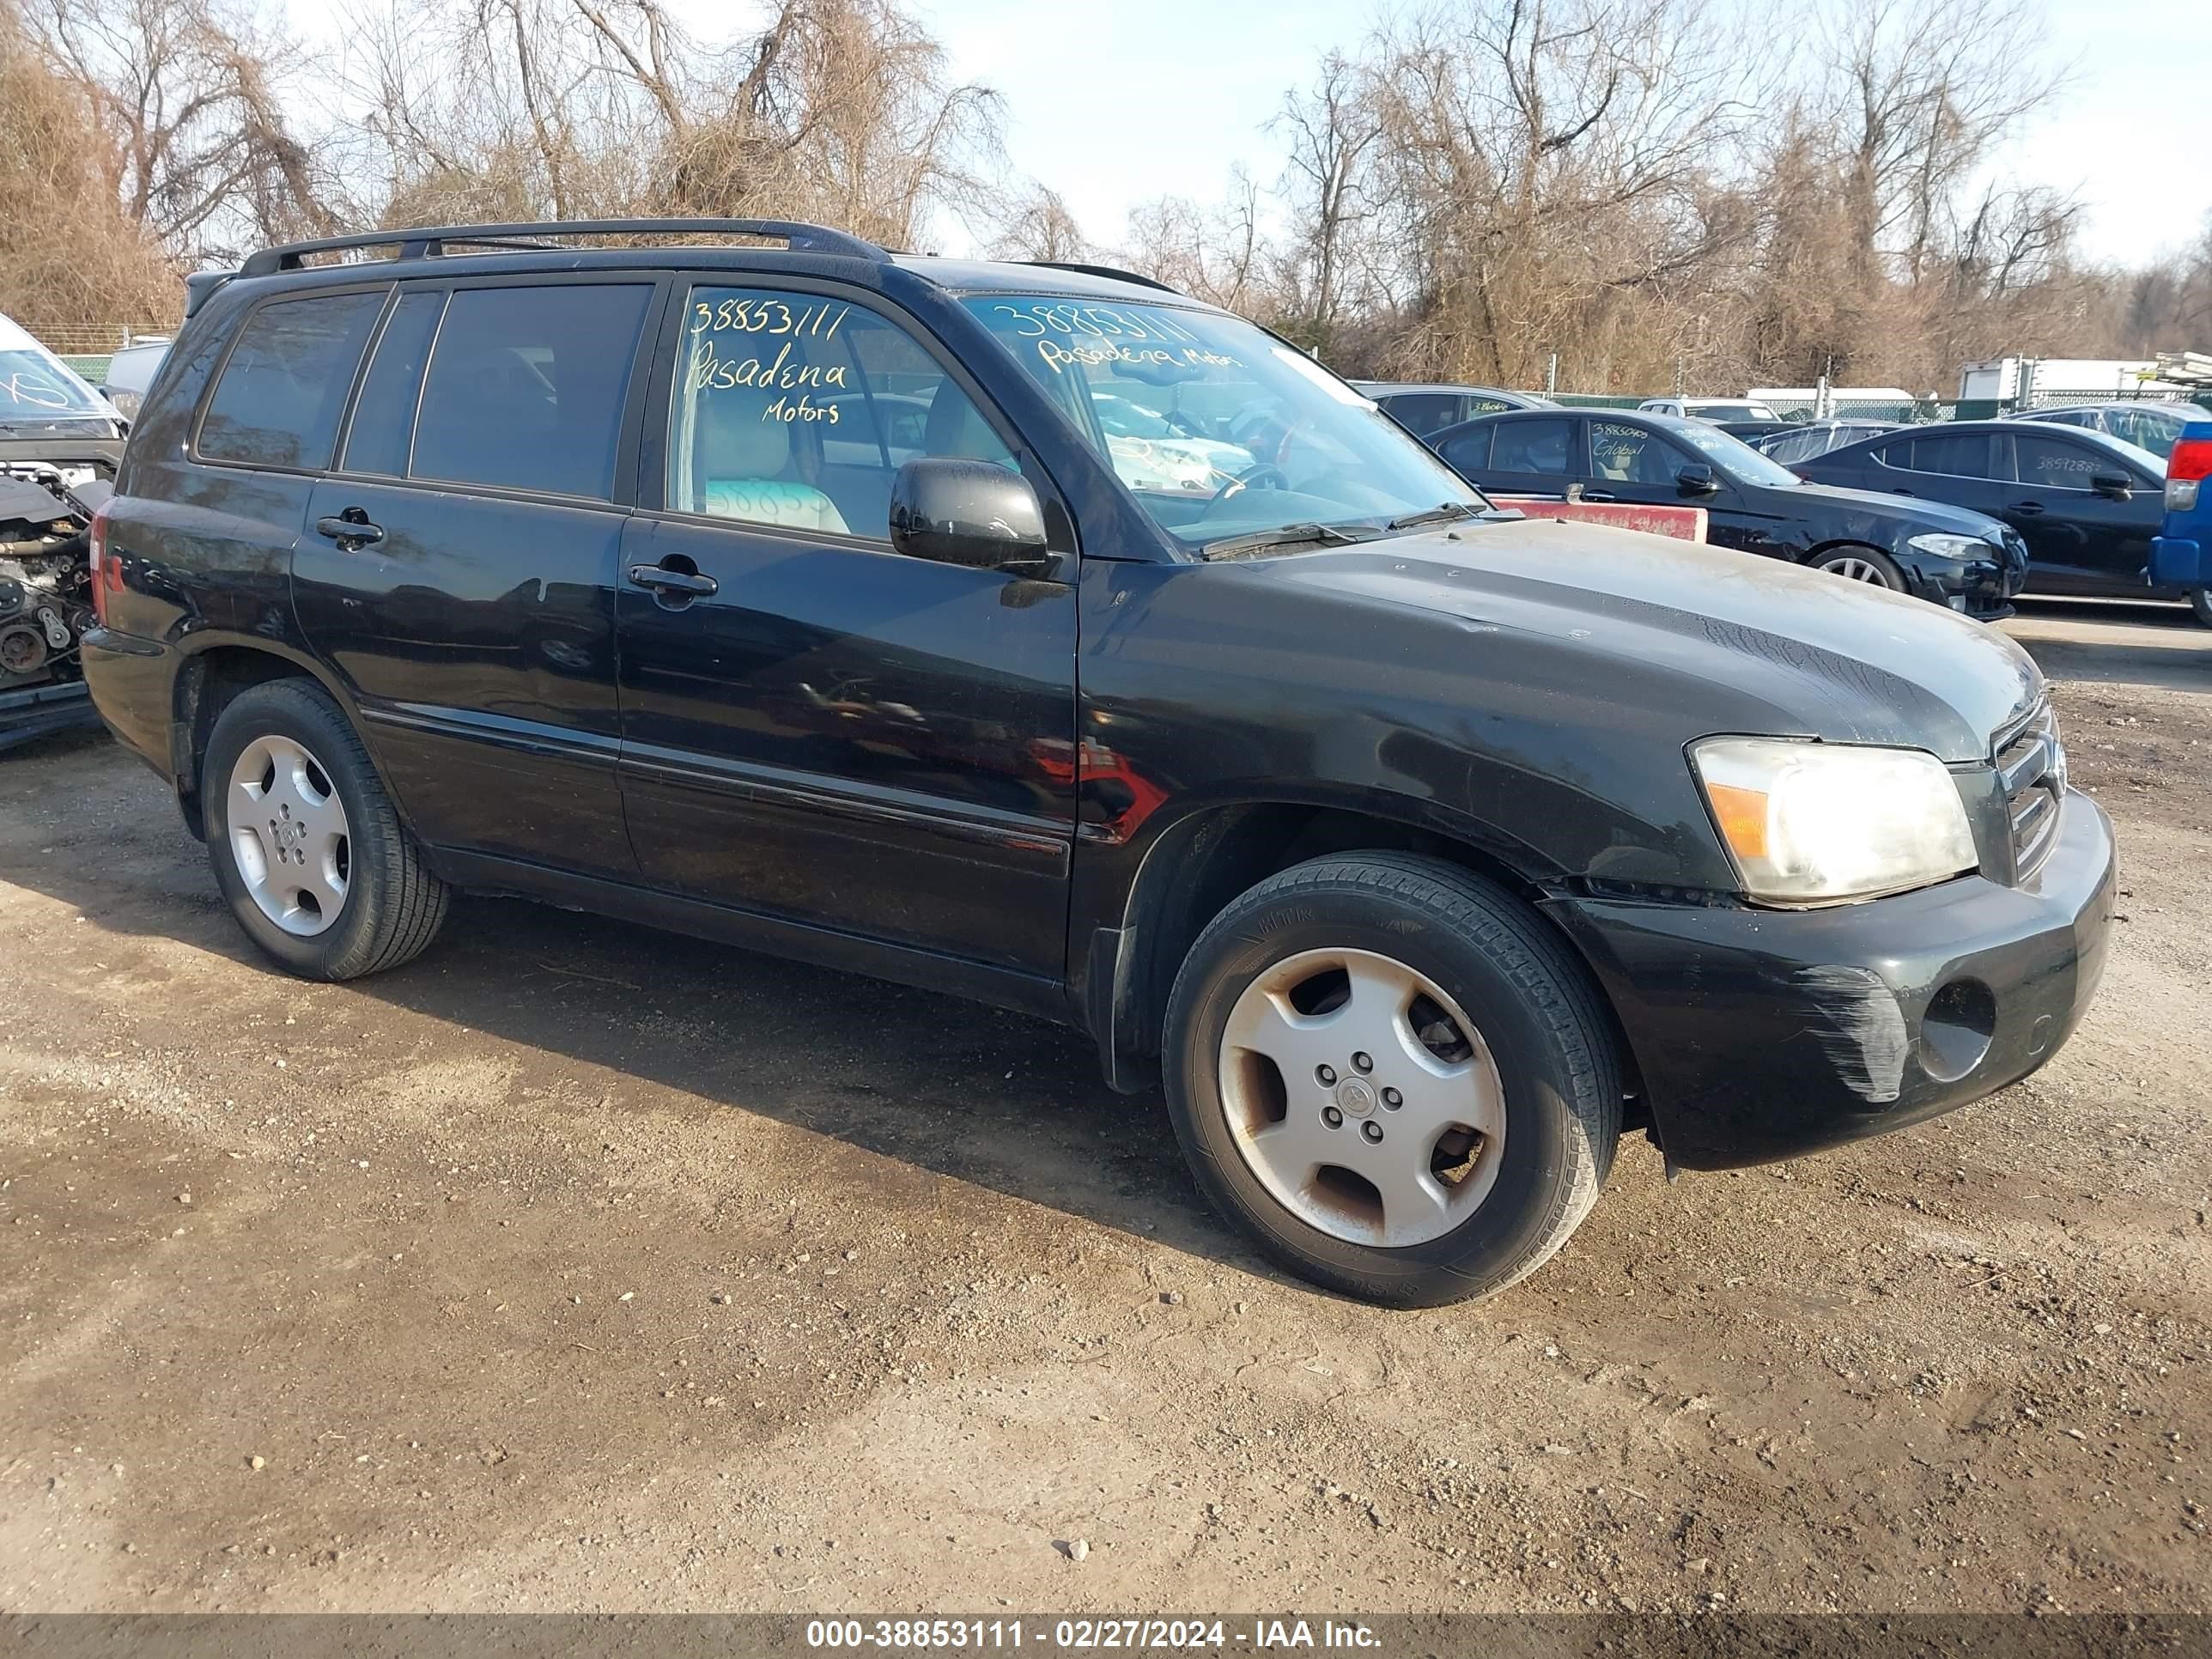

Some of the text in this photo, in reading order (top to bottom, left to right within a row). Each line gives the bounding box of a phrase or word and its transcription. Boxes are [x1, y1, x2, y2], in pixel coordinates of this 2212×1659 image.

[690, 298, 850, 341] 38853111
[994, 305, 1200, 342] 38853111
[684, 341, 847, 393] Pasadena
[1038, 337, 1186, 374] Pasadena
[762, 397, 839, 424] Motors
[1593, 439, 1646, 458] Global
